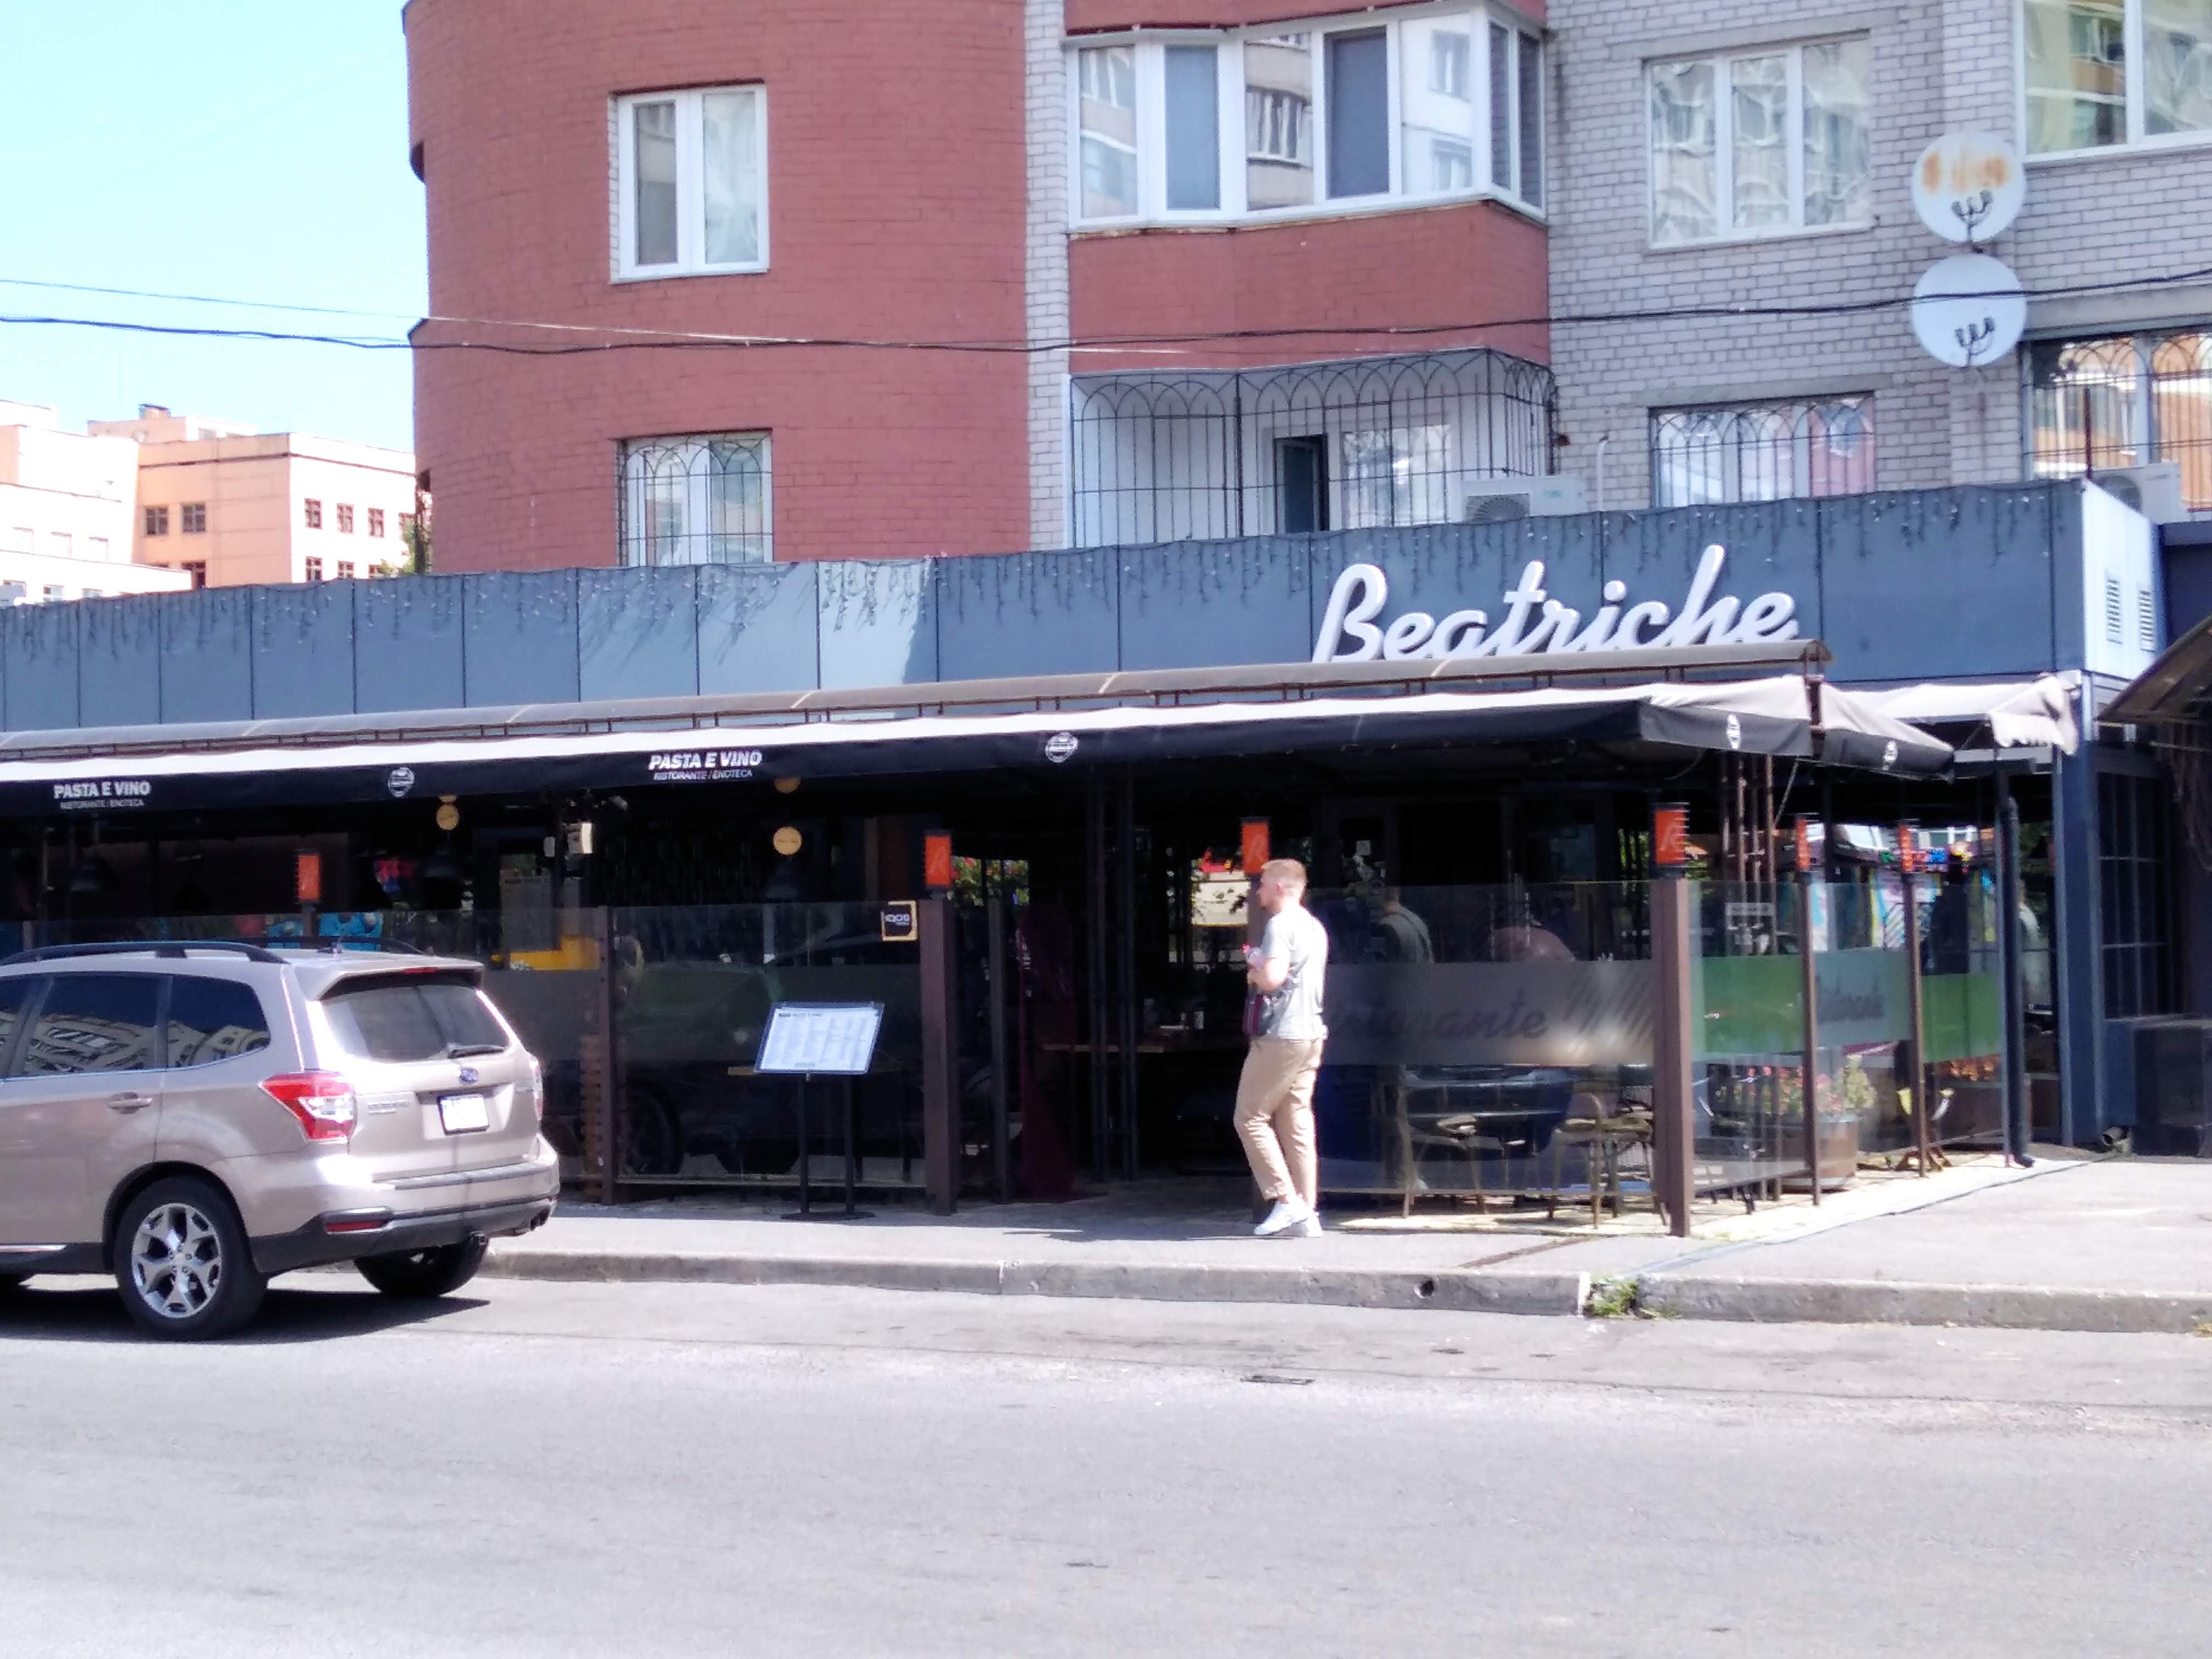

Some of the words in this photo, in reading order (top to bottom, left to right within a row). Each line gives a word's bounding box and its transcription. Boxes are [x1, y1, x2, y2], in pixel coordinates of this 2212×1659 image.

[1312, 545, 1799, 662] Beatriche
[648, 754, 702, 770] PASTA
[704, 752, 718, 768] E
[720, 751, 763, 766] VINO
[54, 782, 99, 799] PASTA
[101, 781, 112, 795] E
[114, 780, 150, 795] VINO
